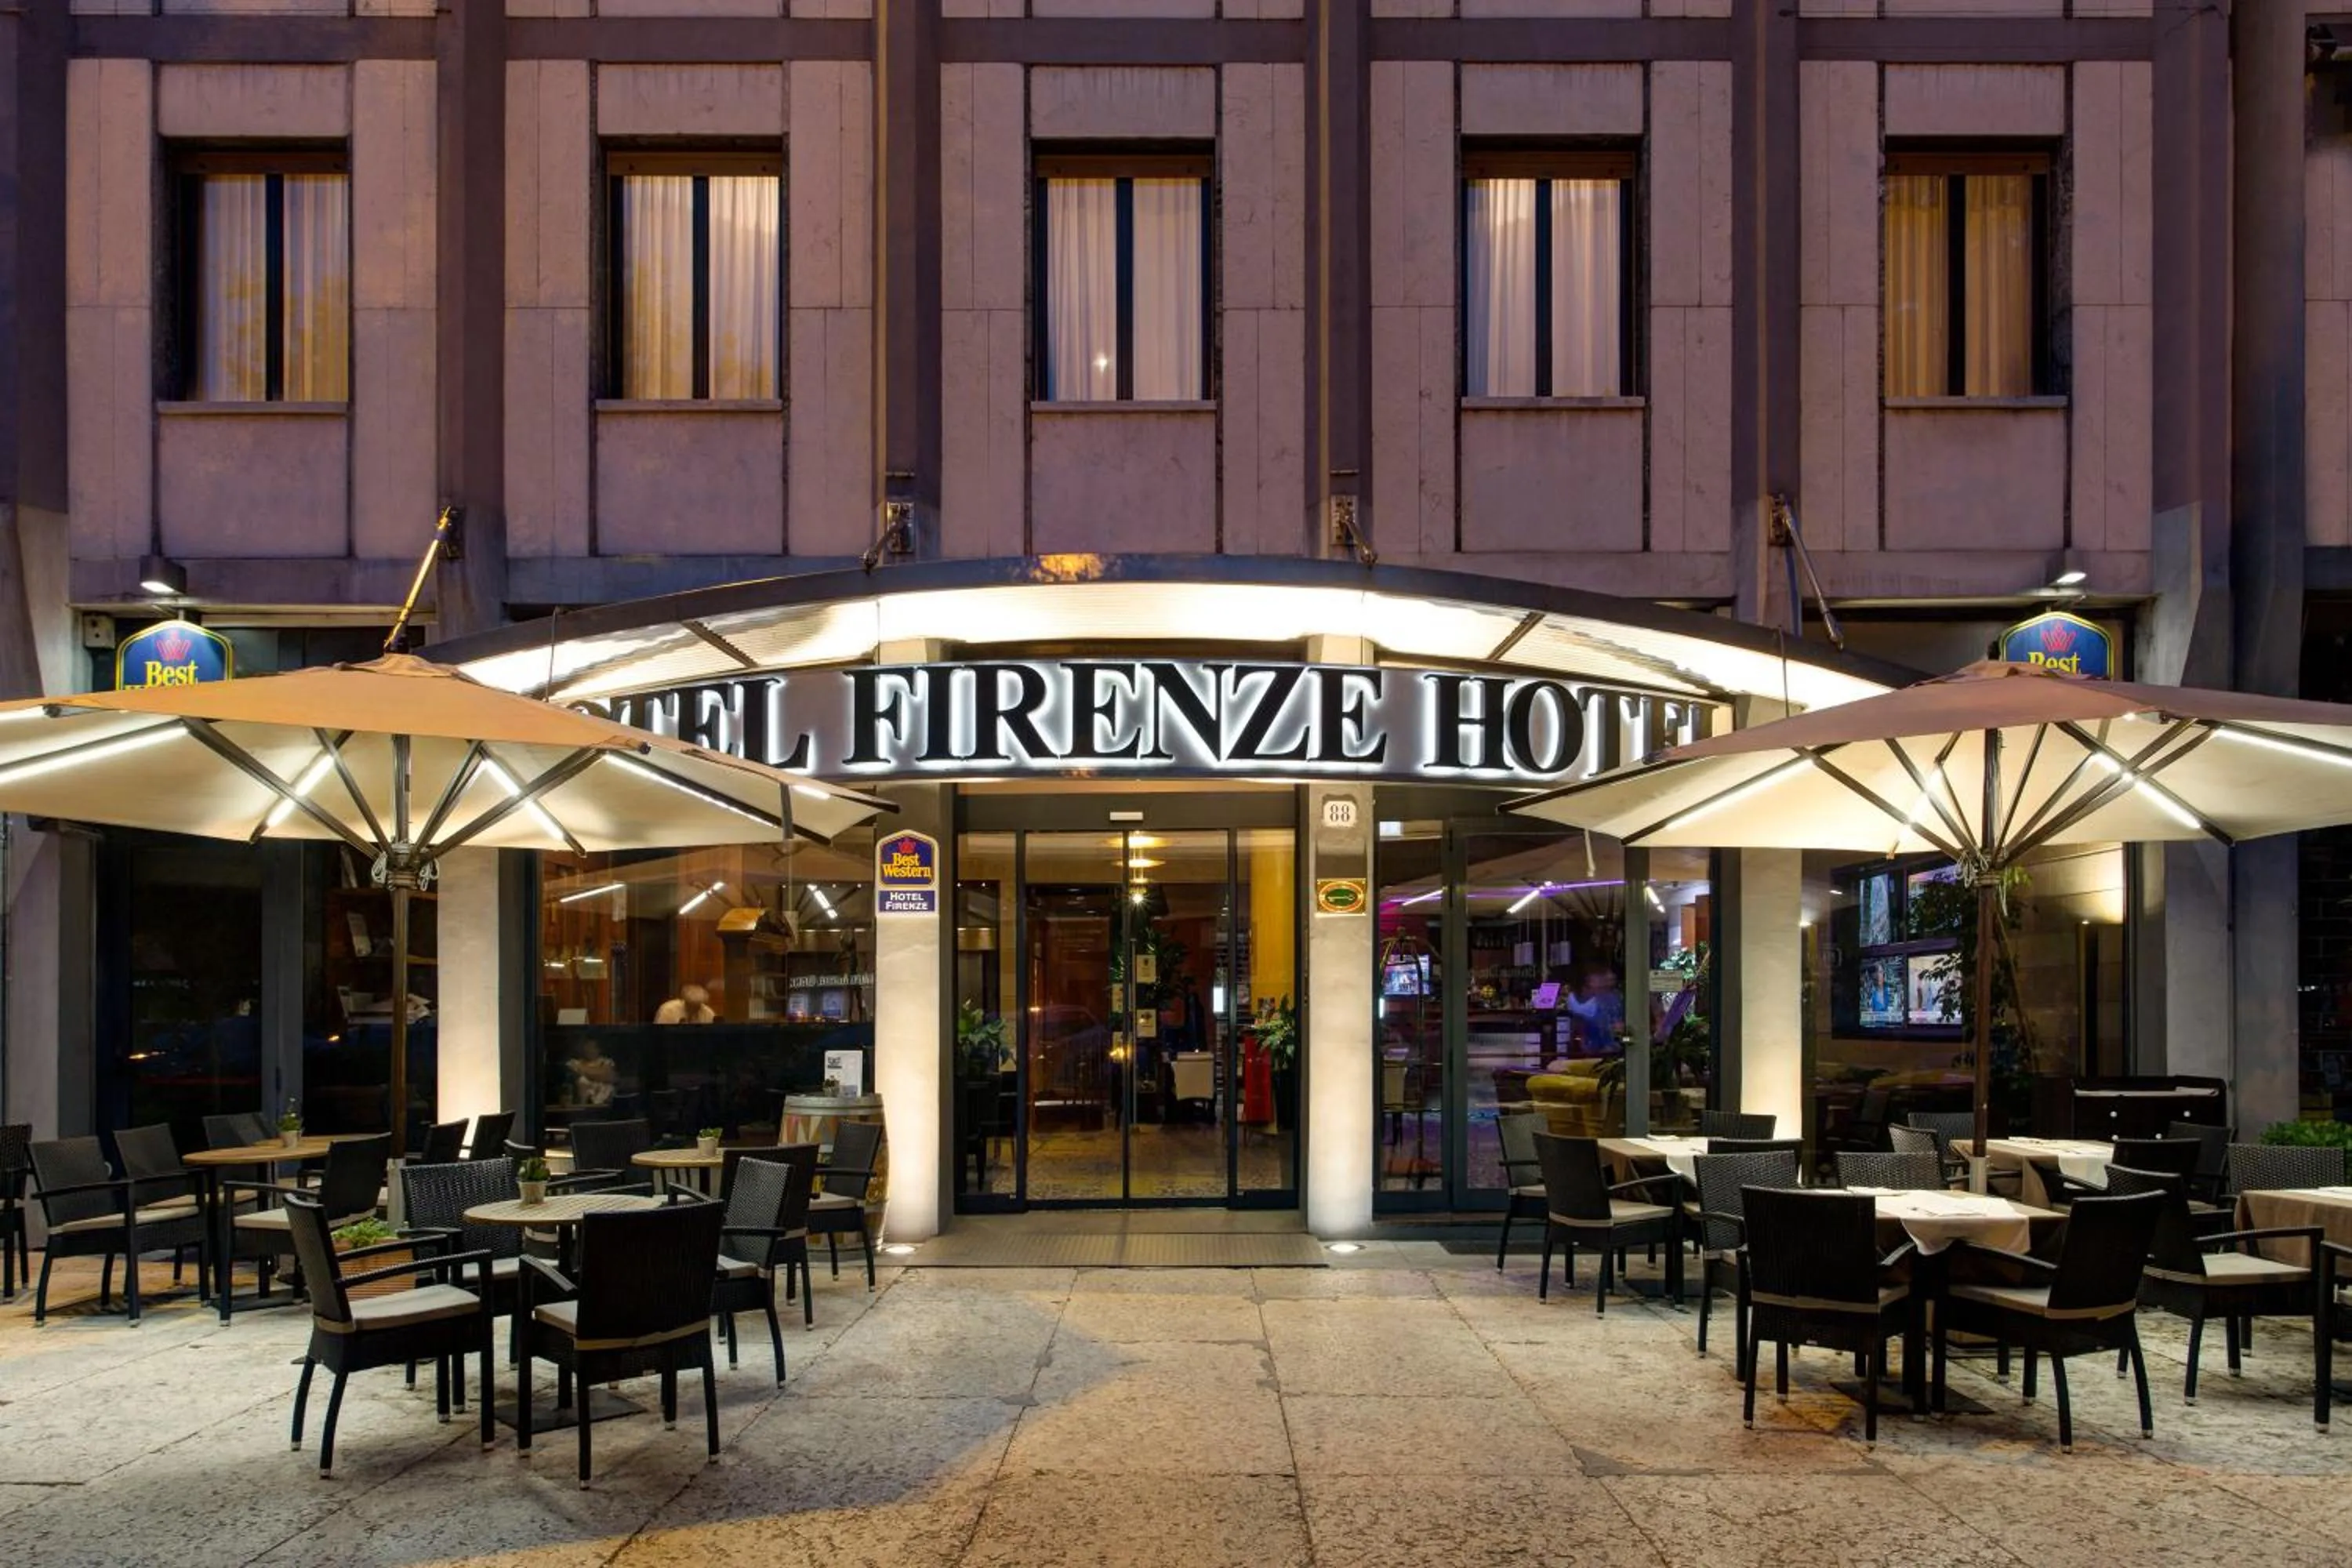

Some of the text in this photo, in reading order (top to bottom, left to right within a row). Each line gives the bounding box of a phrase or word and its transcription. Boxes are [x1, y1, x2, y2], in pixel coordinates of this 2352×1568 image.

[144, 659, 198, 687] Best
[842, 662, 1387, 765] FIRENZE
[1329, 804, 1350, 822] 88
[891, 852, 920, 866] Best
[882, 864, 931, 878] Western
[890, 891, 924, 902] HOTEL
[884, 901, 929, 910] FIRENZE
